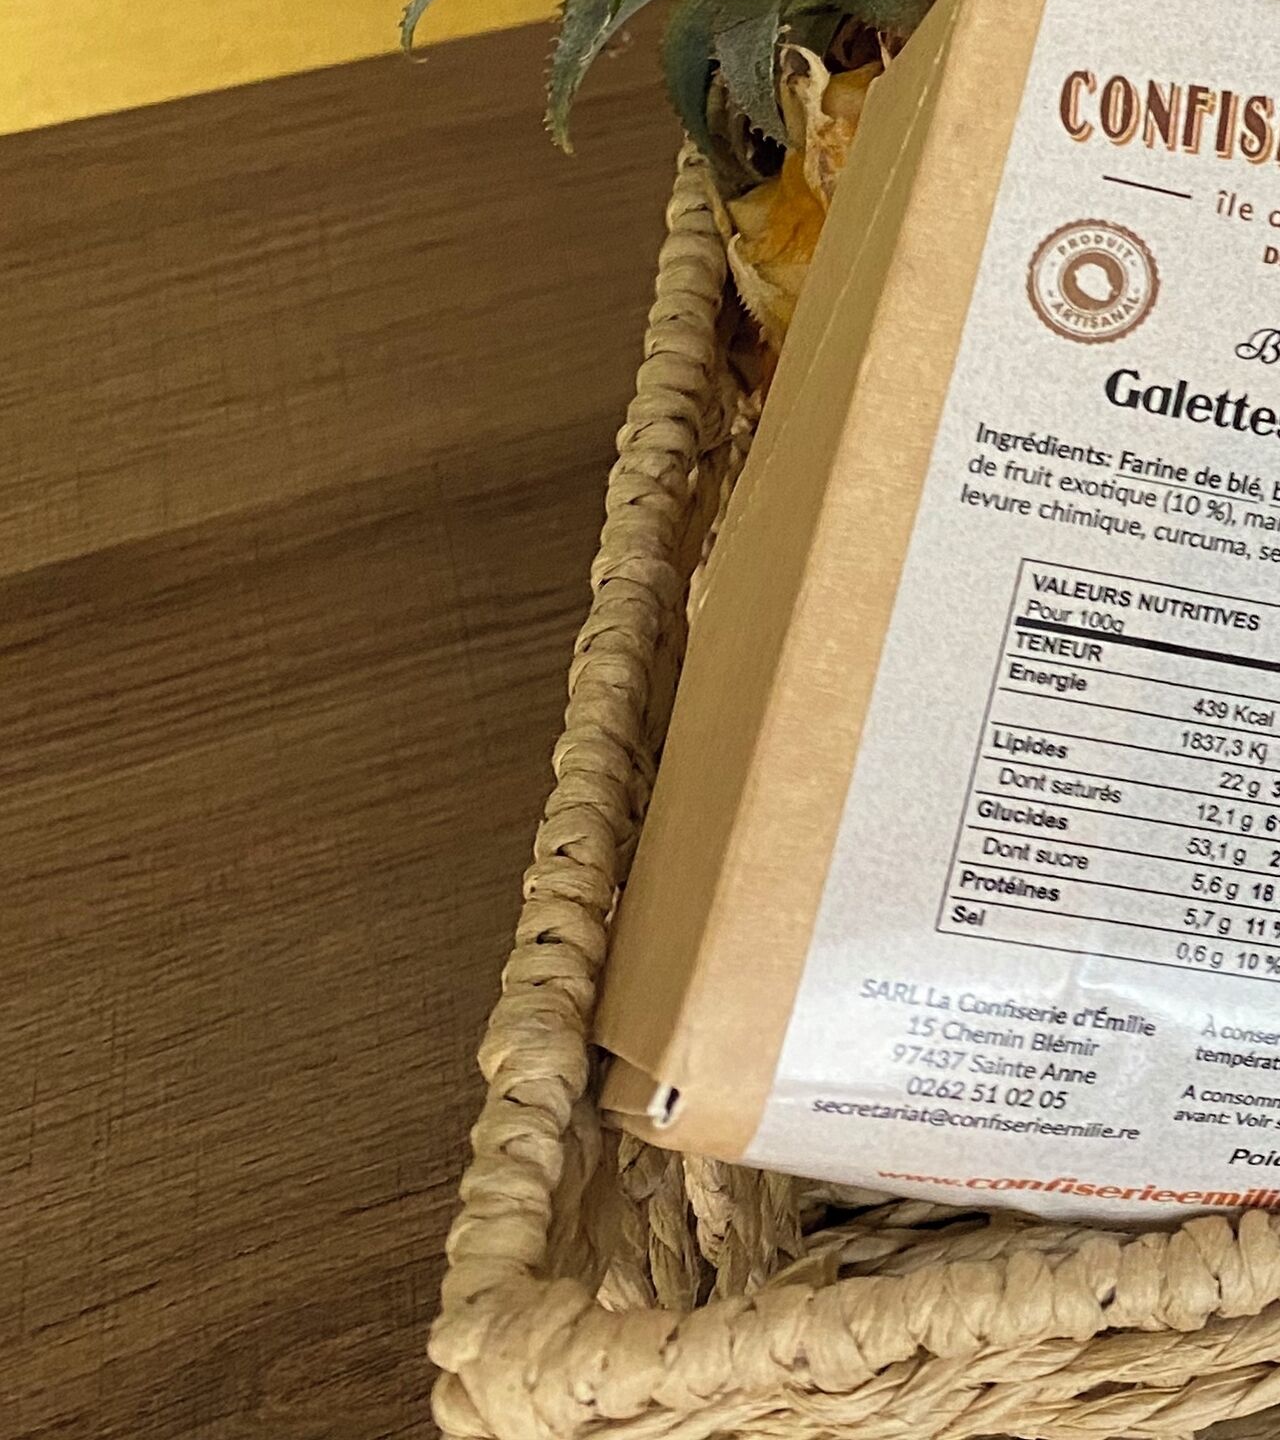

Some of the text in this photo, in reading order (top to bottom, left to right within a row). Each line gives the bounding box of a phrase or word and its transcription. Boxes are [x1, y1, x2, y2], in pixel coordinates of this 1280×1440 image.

[1216, 190, 1253, 221] île
[1058, 234, 1133, 258] PRODUIT
[1052, 297, 1139, 329] ARTISANAL
[968, 455, 997, 476] de
[1003, 460, 1052, 489] fruit
[1060, 474, 1157, 508] exotique
[1164, 490, 1200, 516] (10
[1207, 499, 1236, 526] %),
[976, 422, 1113, 468] Ingrédients:
[1119, 450, 1187, 482] Farine
[1194, 465, 1221, 489] de
[1227, 472, 1264, 502] blé,
[960, 483, 1031, 515] levure
[1039, 497, 1147, 540] chimique,
[1154, 523, 1251, 559] curcuma,
[1025, 599, 1125, 634] Pour 100g
[1032, 574, 1261, 631] VALEURS NUTRITIVES
[1015, 633, 1103, 661] TENEUR
[1008, 664, 1275, 727] Energie 439 Kcal
[992, 730, 1069, 759] Lipides
[1219, 771, 1245, 792] 22
[1181, 730, 1243, 757] 1837,3
[999, 767, 1046, 792] Dont
[1050, 779, 1122, 804] saturés
[1197, 804, 1236, 827] 12,1
[977, 800, 1069, 831] Glucides
[1186, 836, 1228, 859] 53,1
[982, 837, 1274, 902] Dont sucre 5,6 18
[959, 870, 1265, 936] Protéines 5,7 11
[951, 905, 1259, 971] Sel 0,6 10
[860, 979, 1156, 1037] SARL La Confiserie d'Émilie
[907, 1016, 1101, 1057] 15 Chemin Blémir
[891, 1043, 1097, 1085] 97437 Sainte Anne
[907, 1076, 1069, 1110] 0262 51 02 05
[1235, 1112, 1273, 1128] Voir
